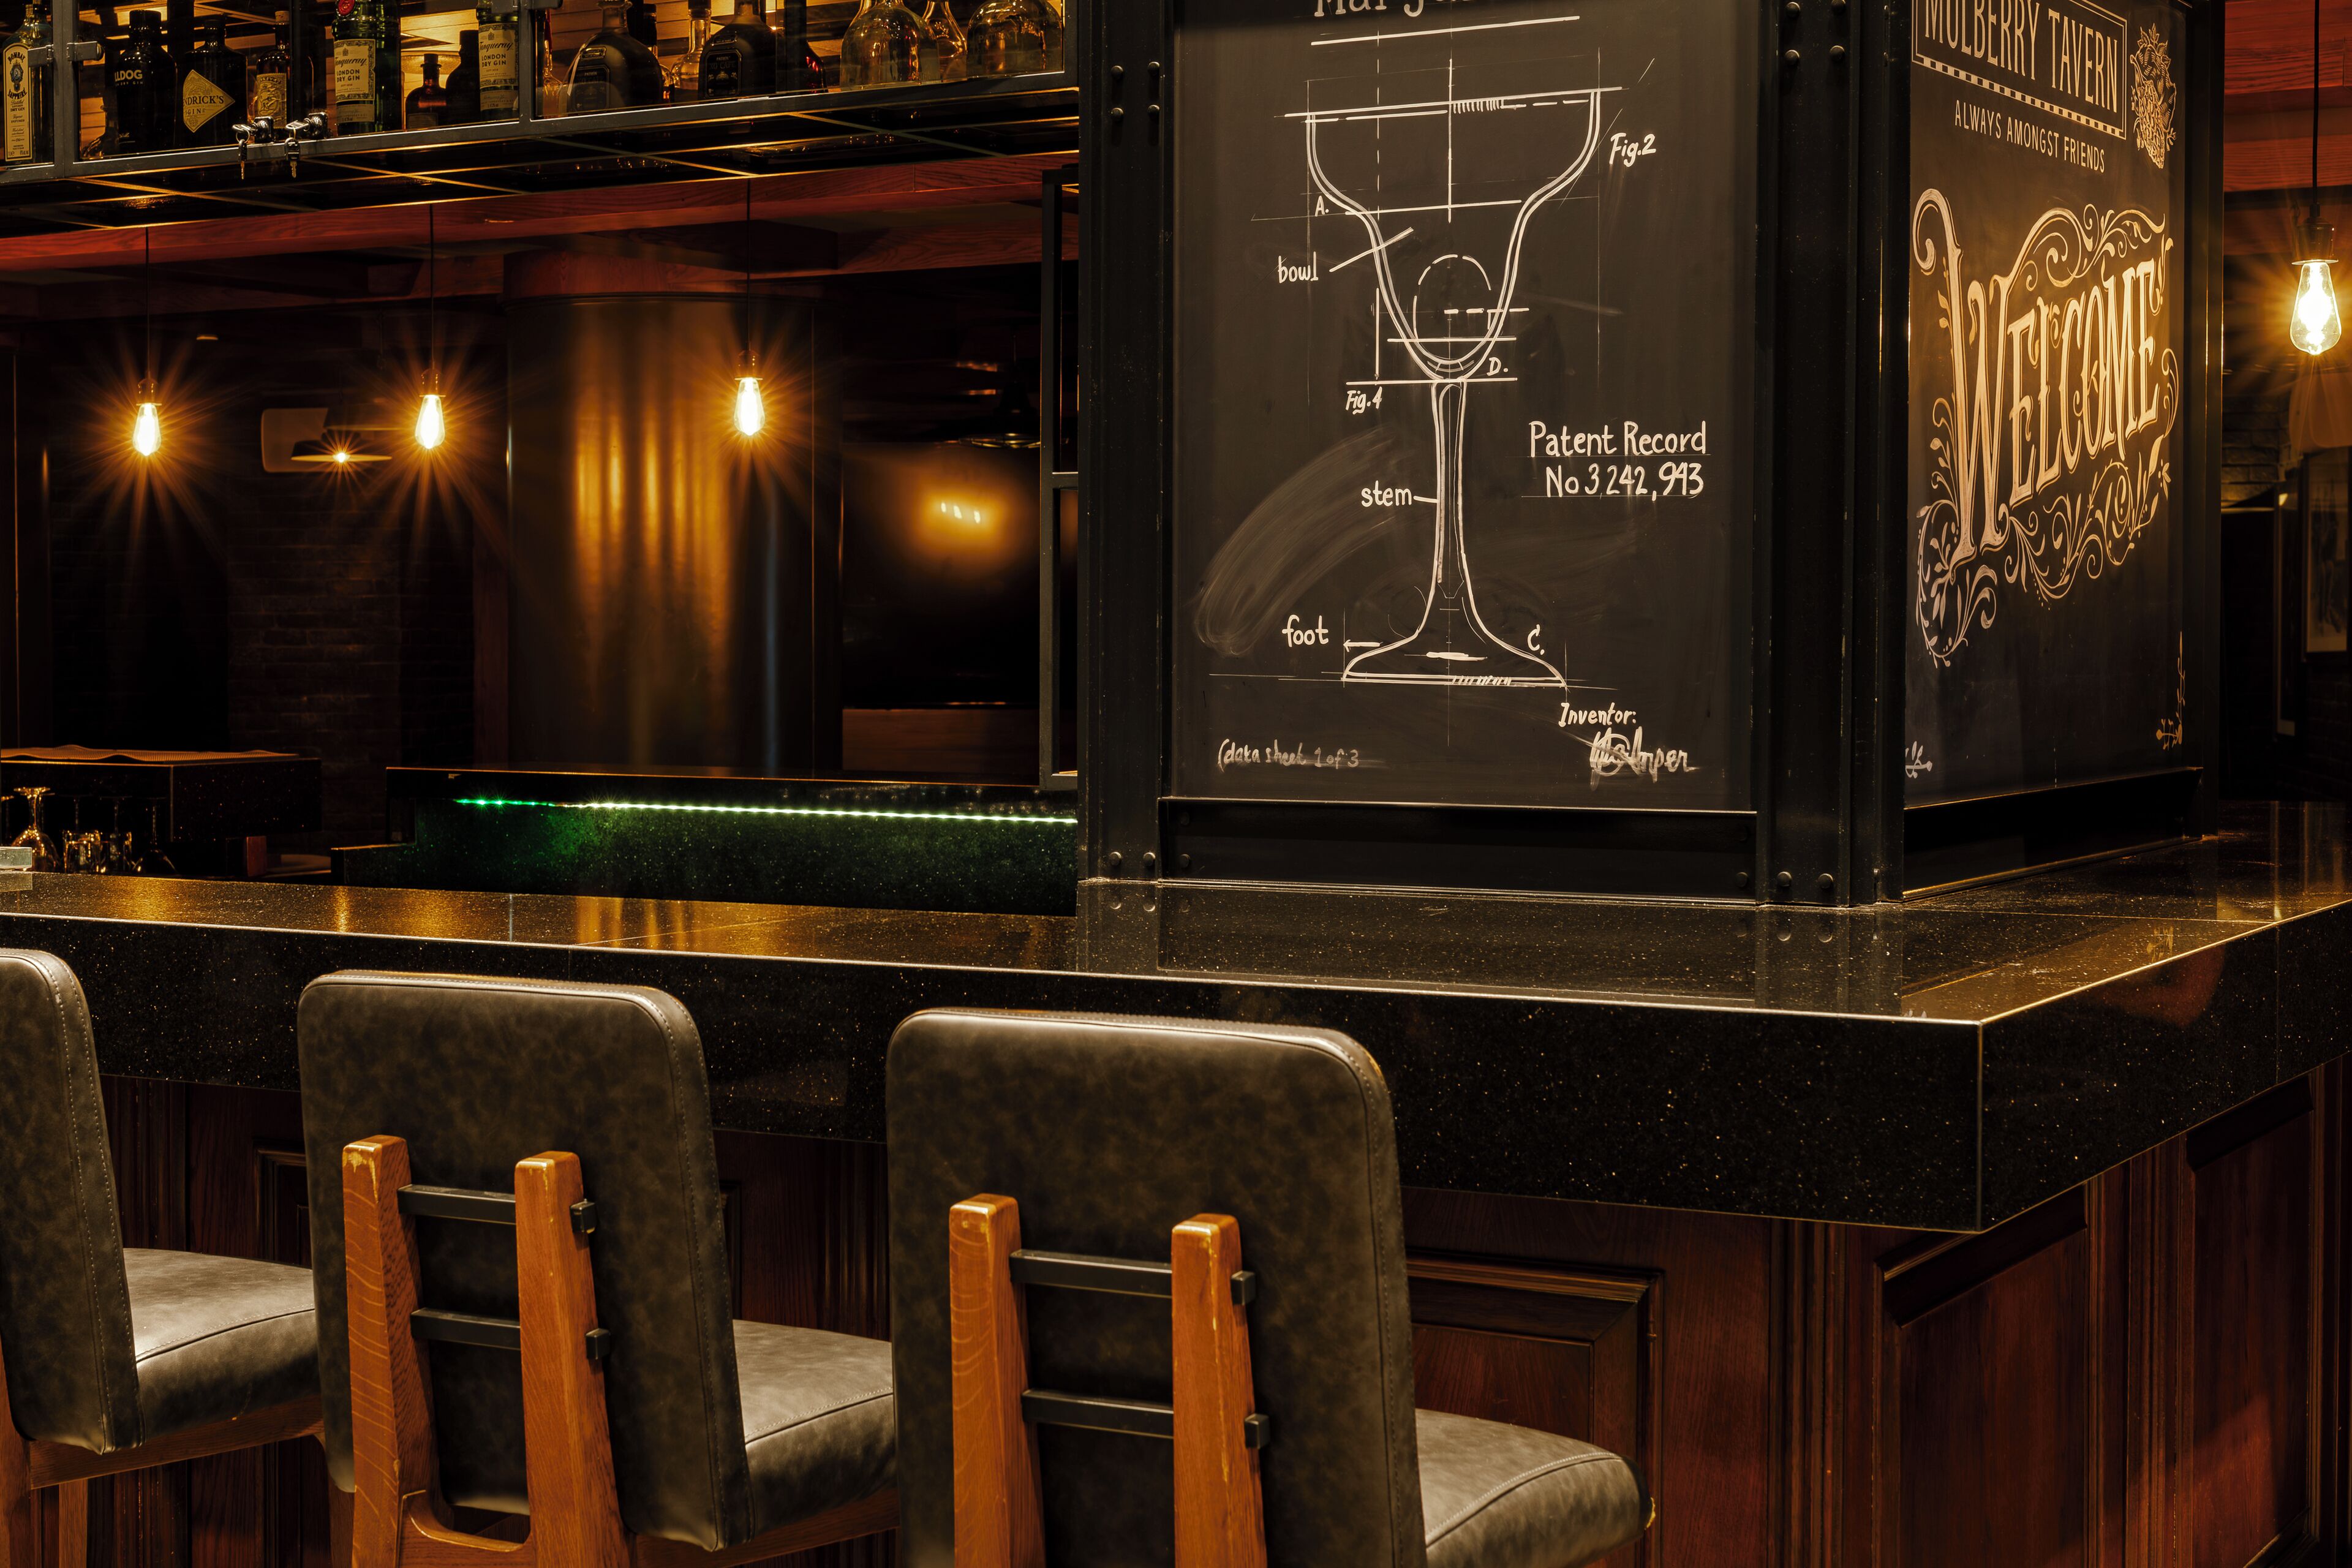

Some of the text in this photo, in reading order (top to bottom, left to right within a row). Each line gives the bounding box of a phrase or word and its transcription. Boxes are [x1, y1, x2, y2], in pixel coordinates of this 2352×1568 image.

[7, 51, 26, 64] BOMBAY
[480, 42, 513, 52] Tanqueray
[2048, 8, 2118, 113] TAVERN
[1609, 132, 1657, 167] Fig.2
[1954, 99, 2105, 173] ALWAYS AMONGST FRIENDS
[1278, 255, 1319, 284] bowl
[1912, 187, 2165, 576] WELCOME
[1344, 386, 1382, 416] Fig.4
[1529, 420, 1706, 458] Patent Record
[1361, 480, 1413, 508] stem
[1545, 464, 1579, 497] No
[1281, 614, 1330, 649] foot
[1558, 702, 1637, 727] Inventor:
[1348, 748, 1359, 767] 3
